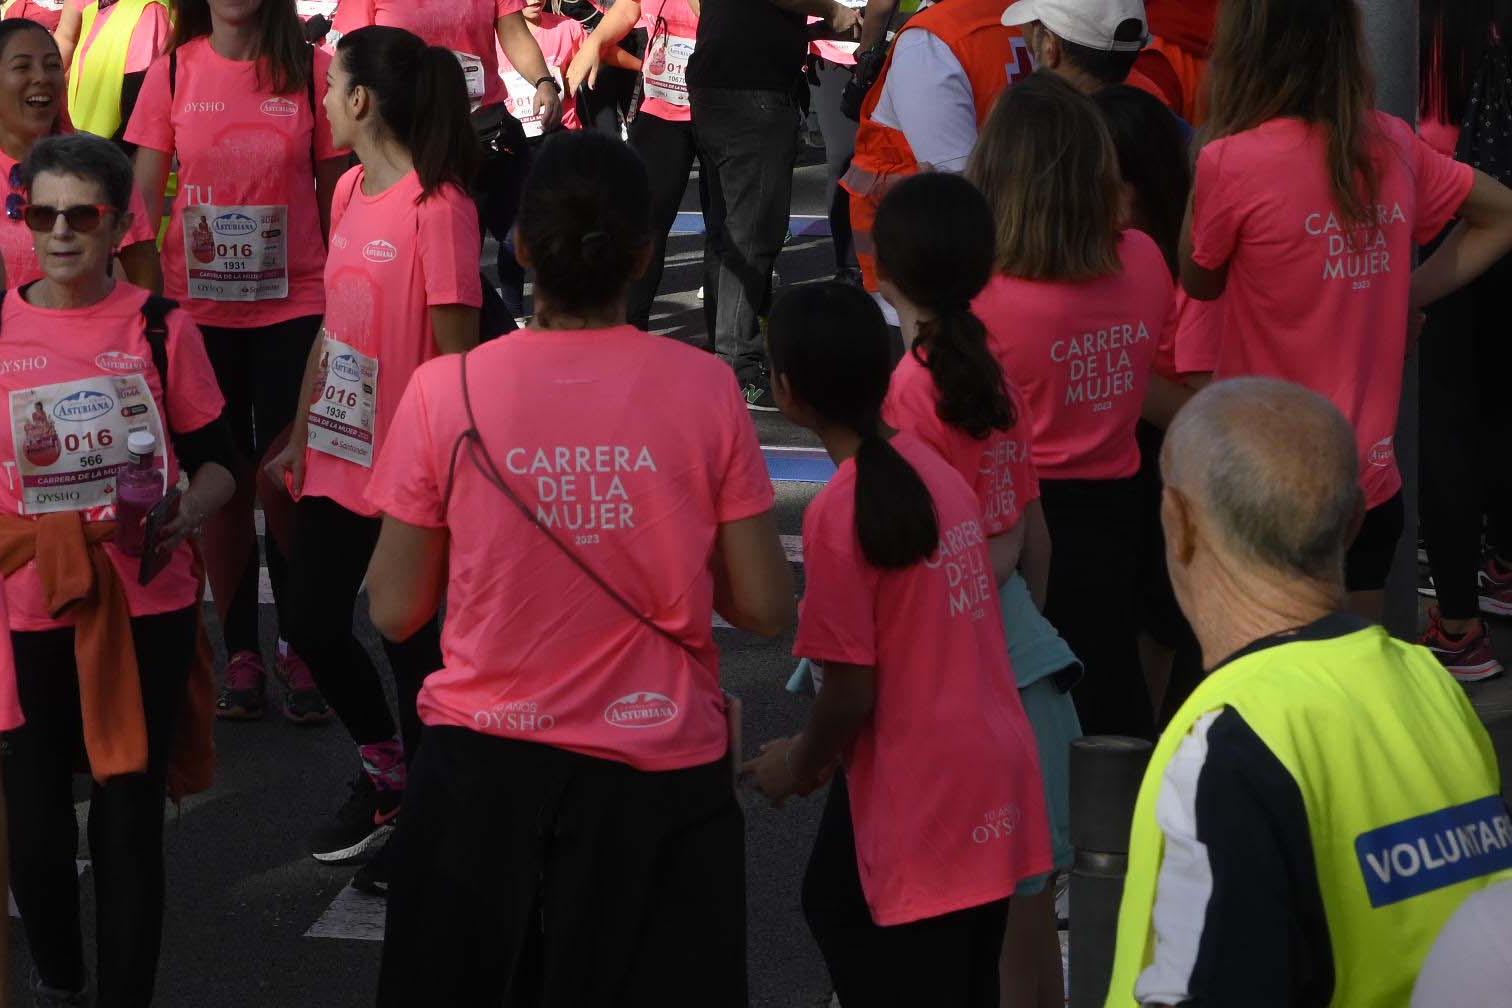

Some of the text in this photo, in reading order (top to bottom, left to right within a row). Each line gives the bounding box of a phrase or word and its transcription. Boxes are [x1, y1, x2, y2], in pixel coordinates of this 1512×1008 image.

[184, 101, 225, 113] OYSHO
[517, 97, 531, 107] 01
[184, 184, 213, 206] TU
[215, 220, 254, 232] ASTURIANA
[217, 243, 253, 257] 016
[223, 261, 246, 270] 1931
[1323, 252, 1391, 280] MUJER
[1051, 321, 1150, 363] CARRERA
[1070, 350, 1131, 381] DE LA
[325, 385, 357, 407] 016
[1064, 373, 1135, 406] MUJER
[57, 400, 110, 417] ASTURIANA
[325, 405, 347, 420] 1936
[64, 428, 113, 452] 016
[80, 454, 103, 468] 566
[506, 445, 658, 474] CARRERA
[37, 473, 77, 485] CARRERA
[91, 470, 103, 479] LA
[36, 491, 80, 503] OYSHO
[537, 475, 628, 502] DE LA
[535, 503, 636, 530] MUJER
[575, 533, 600, 545] 2023
[474, 711, 555, 732] OYSHO
[611, 707, 673, 723] ASTURIANA
[1365, 815, 1512, 884] VOLUNTAR
